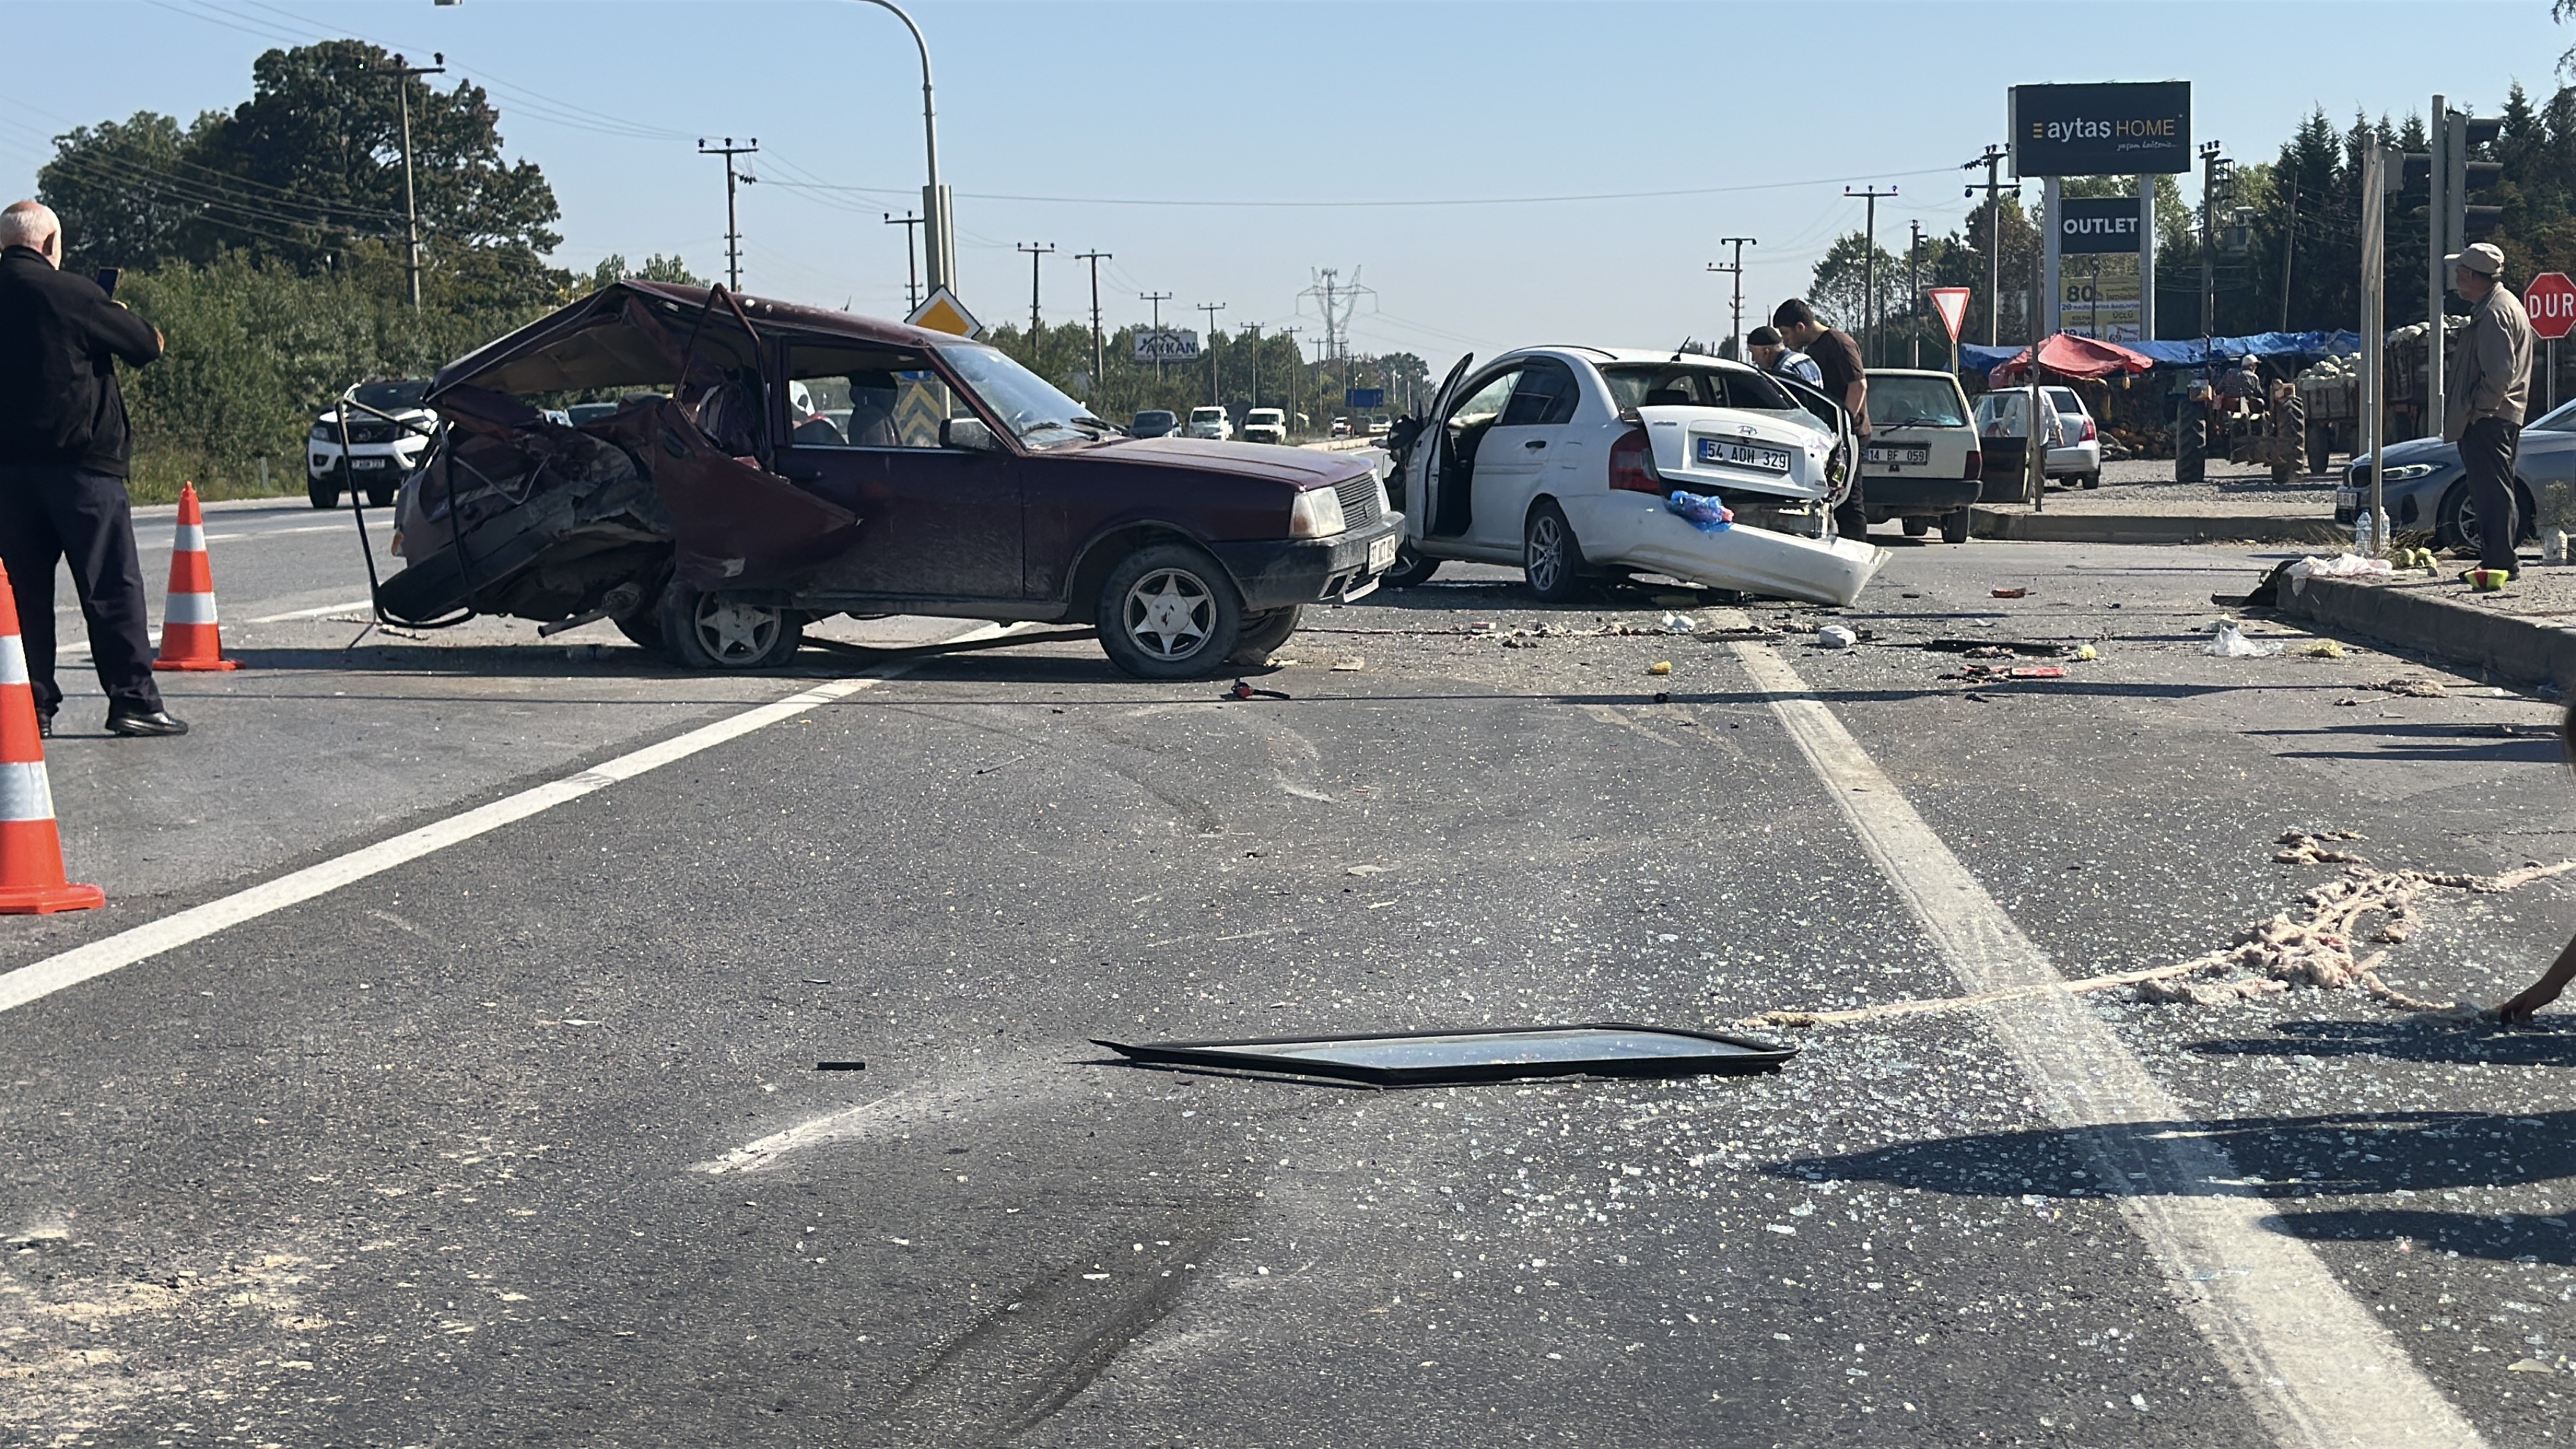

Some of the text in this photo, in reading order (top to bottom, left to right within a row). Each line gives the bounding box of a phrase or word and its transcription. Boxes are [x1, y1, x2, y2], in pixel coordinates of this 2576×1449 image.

[2116, 119, 2175, 137] HOME
[2063, 219, 2138, 235] OUTLET
[2529, 293, 2574, 319] DUR
[1707, 443, 1786, 469] 54 ADH 329
[1870, 450, 1879, 460] 14
[1907, 450, 1924, 461] 059
